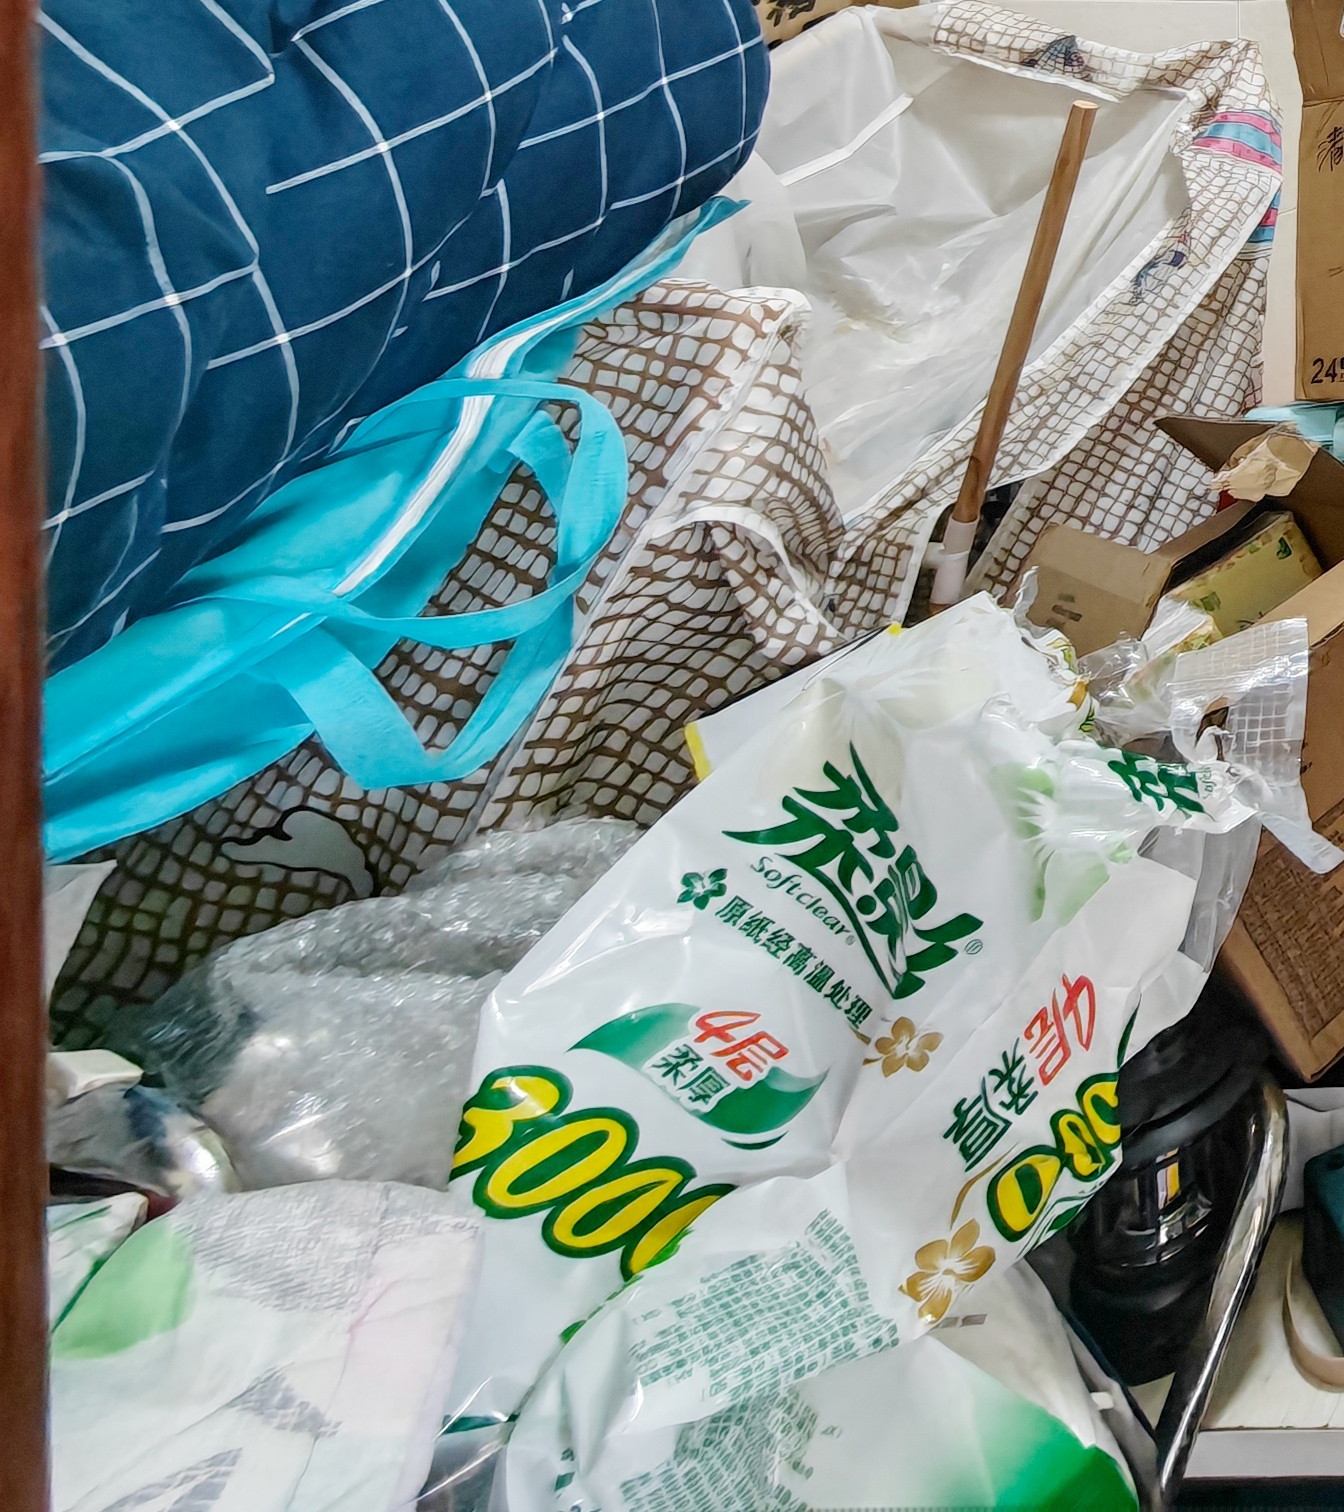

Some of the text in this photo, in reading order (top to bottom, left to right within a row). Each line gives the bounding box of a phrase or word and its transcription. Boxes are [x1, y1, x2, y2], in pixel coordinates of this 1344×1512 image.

[1311, 358, 1338, 384] 24
[750, 856, 852, 938] Softclear
[714, 895, 873, 1029] 原纸经高温处理
[657, 1042, 732, 1108] 柔厚
[694, 1010, 789, 1081] 4层
